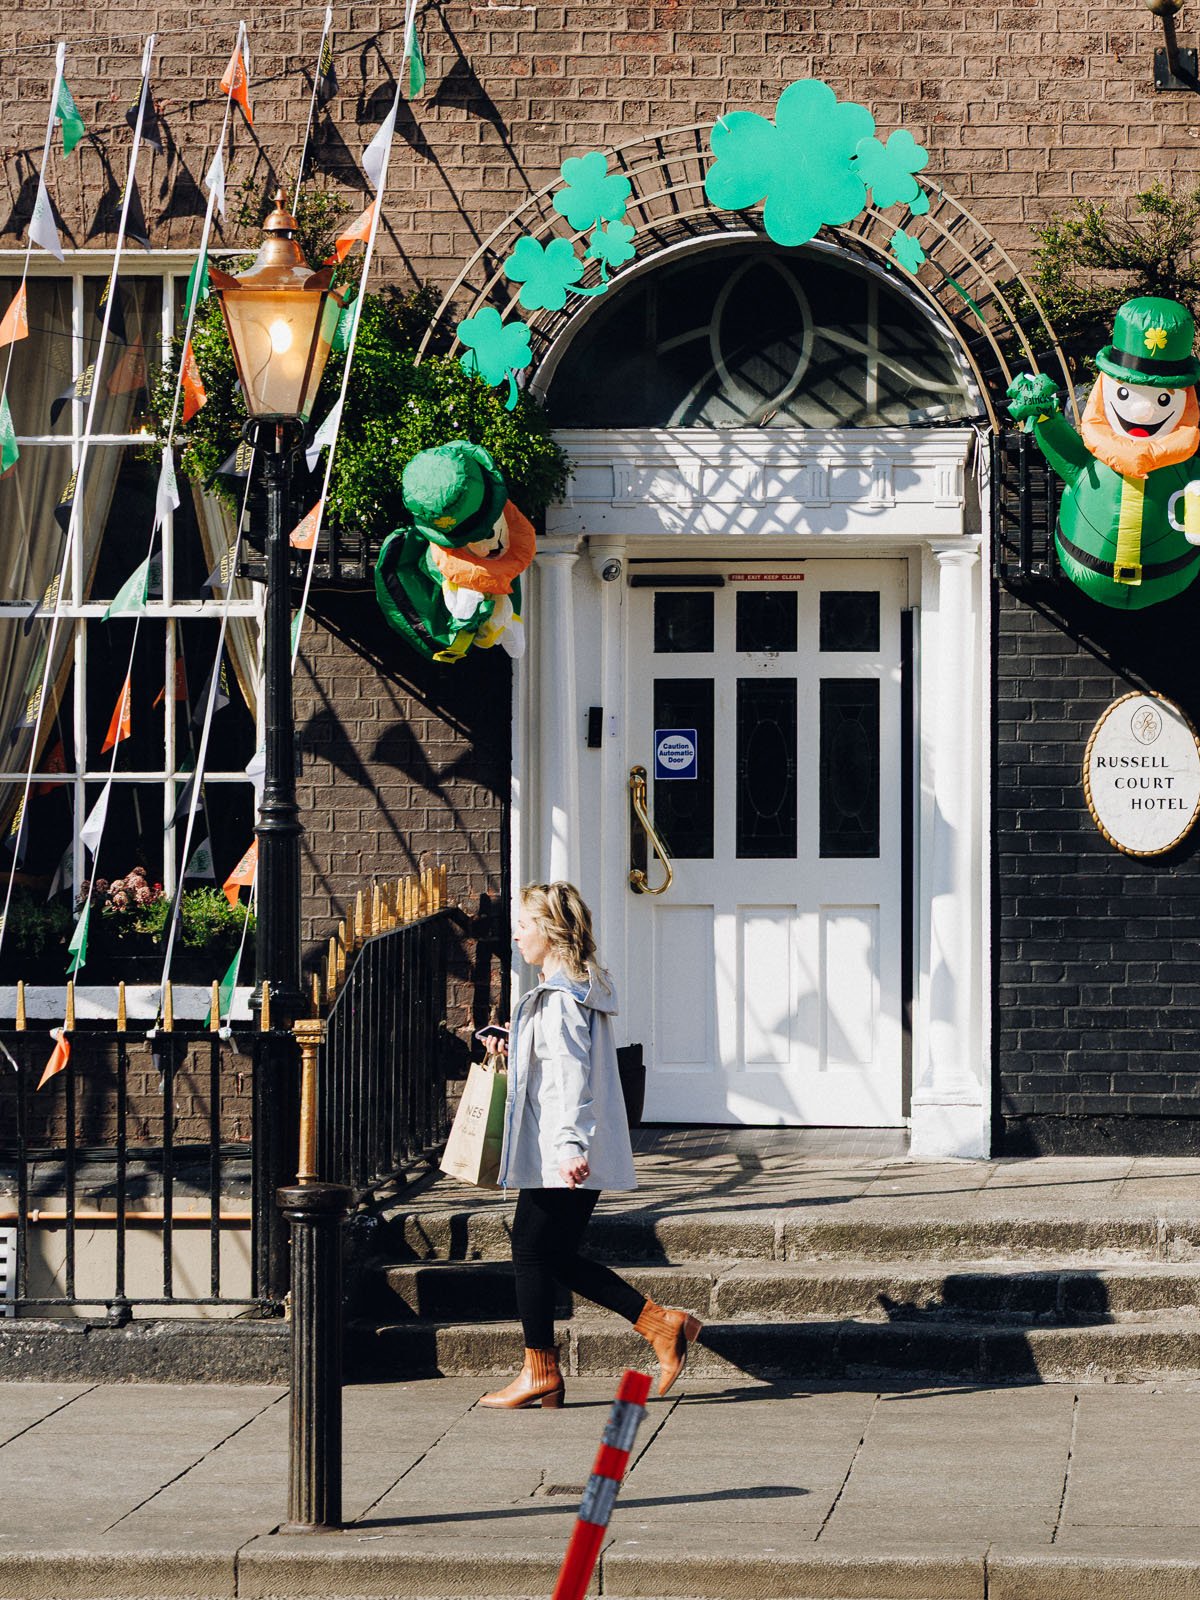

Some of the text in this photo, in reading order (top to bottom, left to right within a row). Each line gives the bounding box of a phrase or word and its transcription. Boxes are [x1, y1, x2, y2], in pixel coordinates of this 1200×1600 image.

[83, 365, 95, 396] DICEY'S
[1097, 757, 1169, 768] RUSSELL
[1114, 778, 1174, 789] COURT
[1131, 798, 1189, 810] HOTEL
